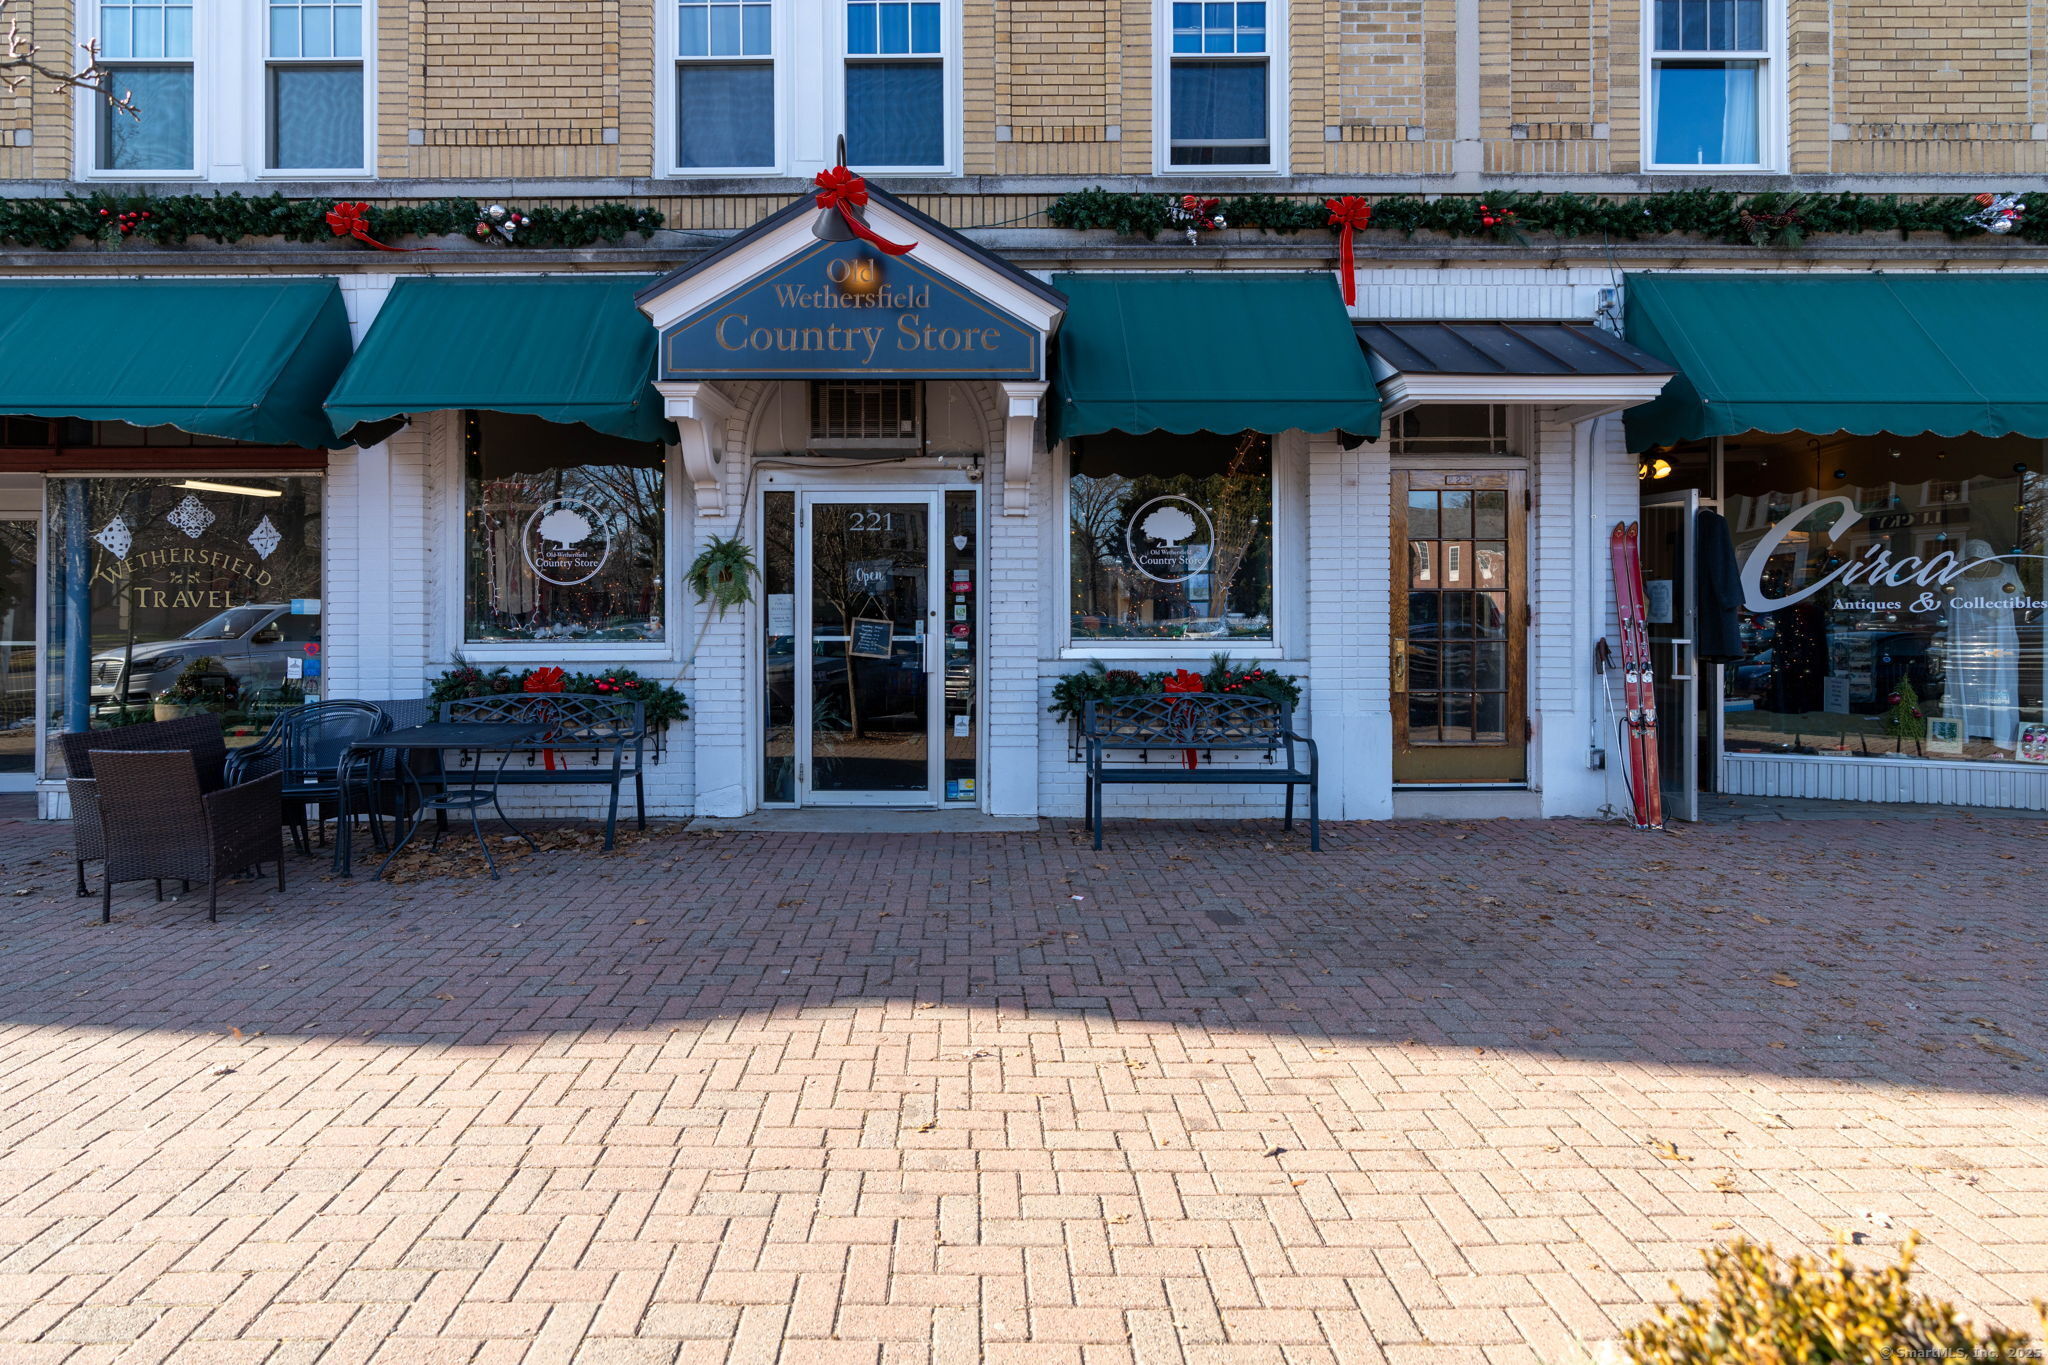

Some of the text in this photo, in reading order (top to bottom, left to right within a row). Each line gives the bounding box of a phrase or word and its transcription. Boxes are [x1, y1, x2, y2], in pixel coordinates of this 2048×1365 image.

[827, 257, 875, 284] Old
[774, 284, 930, 309] Wethersfield
[715, 313, 1001, 365] Country Store
[848, 512, 894, 531] 221
[535, 557, 599, 570] Country Store
[1140, 555, 1203, 568] Country Store
[1740, 495, 2048, 613] Circa
[99, 547, 272, 587] WETHERSFIELD
[856, 567, 884, 586] Open
[133, 586, 236, 609] TRAVEL
[1832, 592, 2048, 613] Antiques & Collectibles
